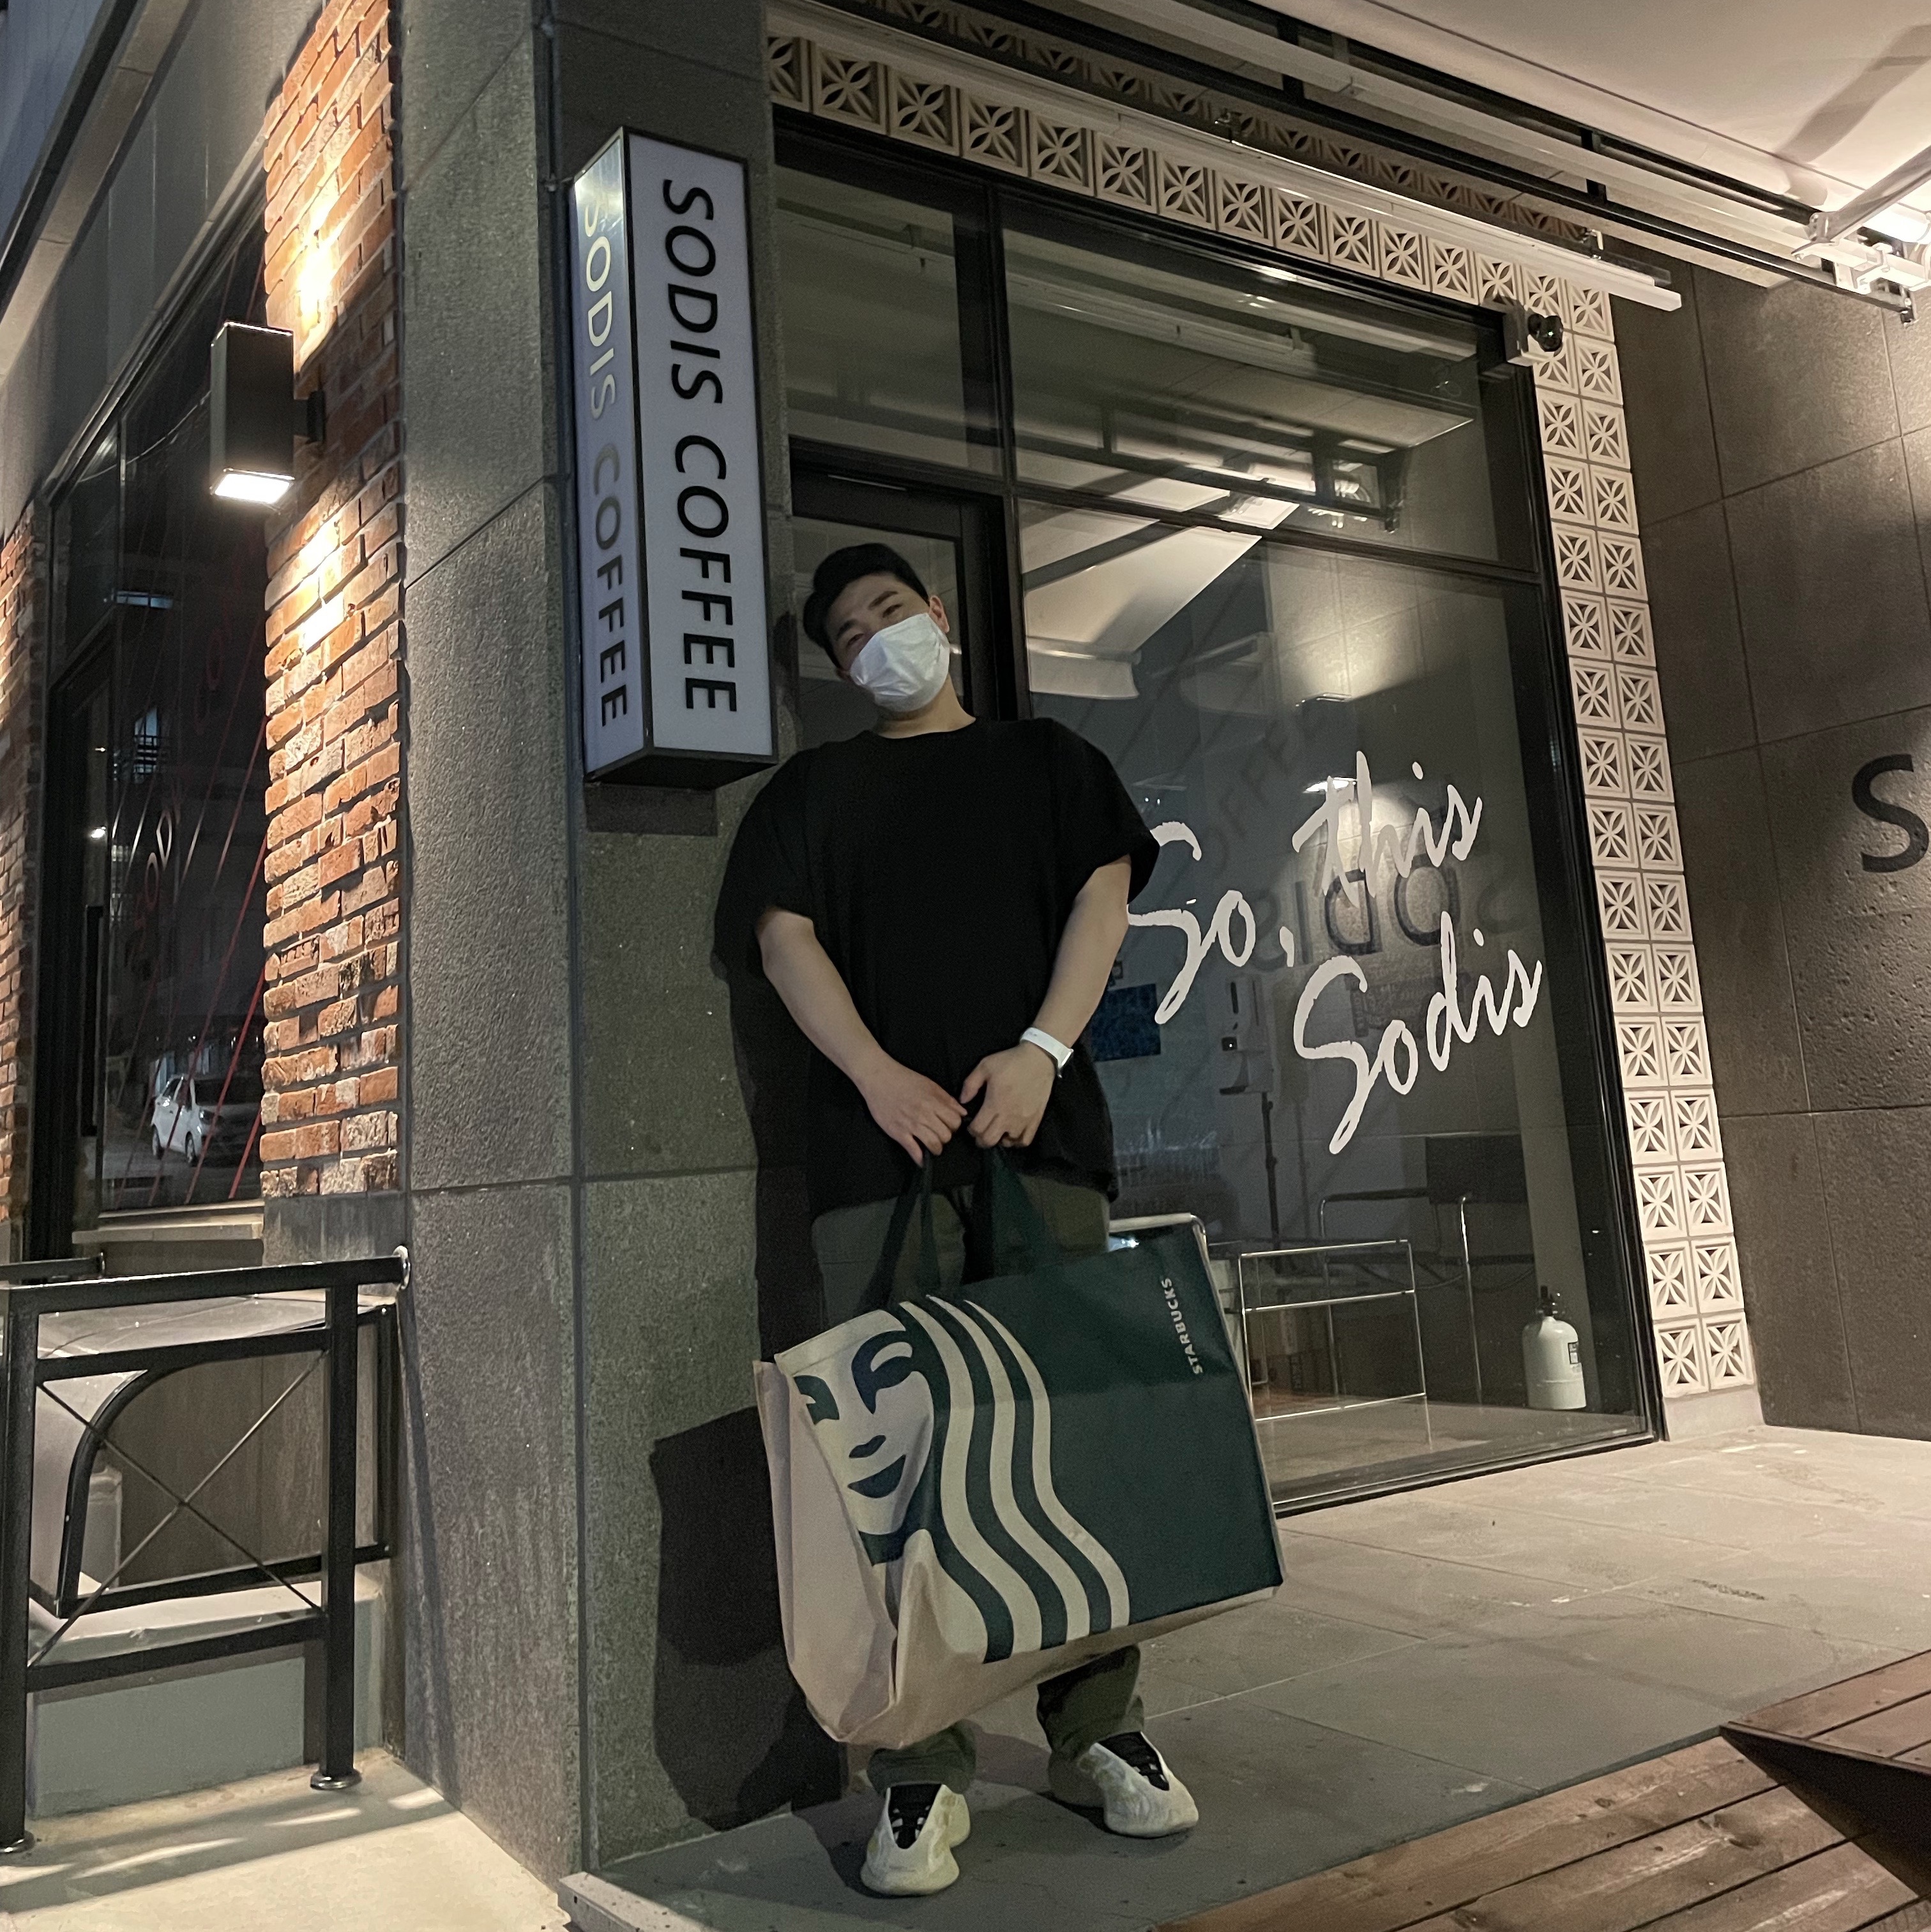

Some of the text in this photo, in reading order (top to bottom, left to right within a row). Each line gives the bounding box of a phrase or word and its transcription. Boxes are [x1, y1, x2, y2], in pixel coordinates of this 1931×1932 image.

[662, 179, 738, 712] SODIS COFFEE
[593, 443, 629, 729] COFFEE
[1293, 911, 1543, 1155] Sodis
[1160, 1277, 1204, 1374] STARBUCKS
